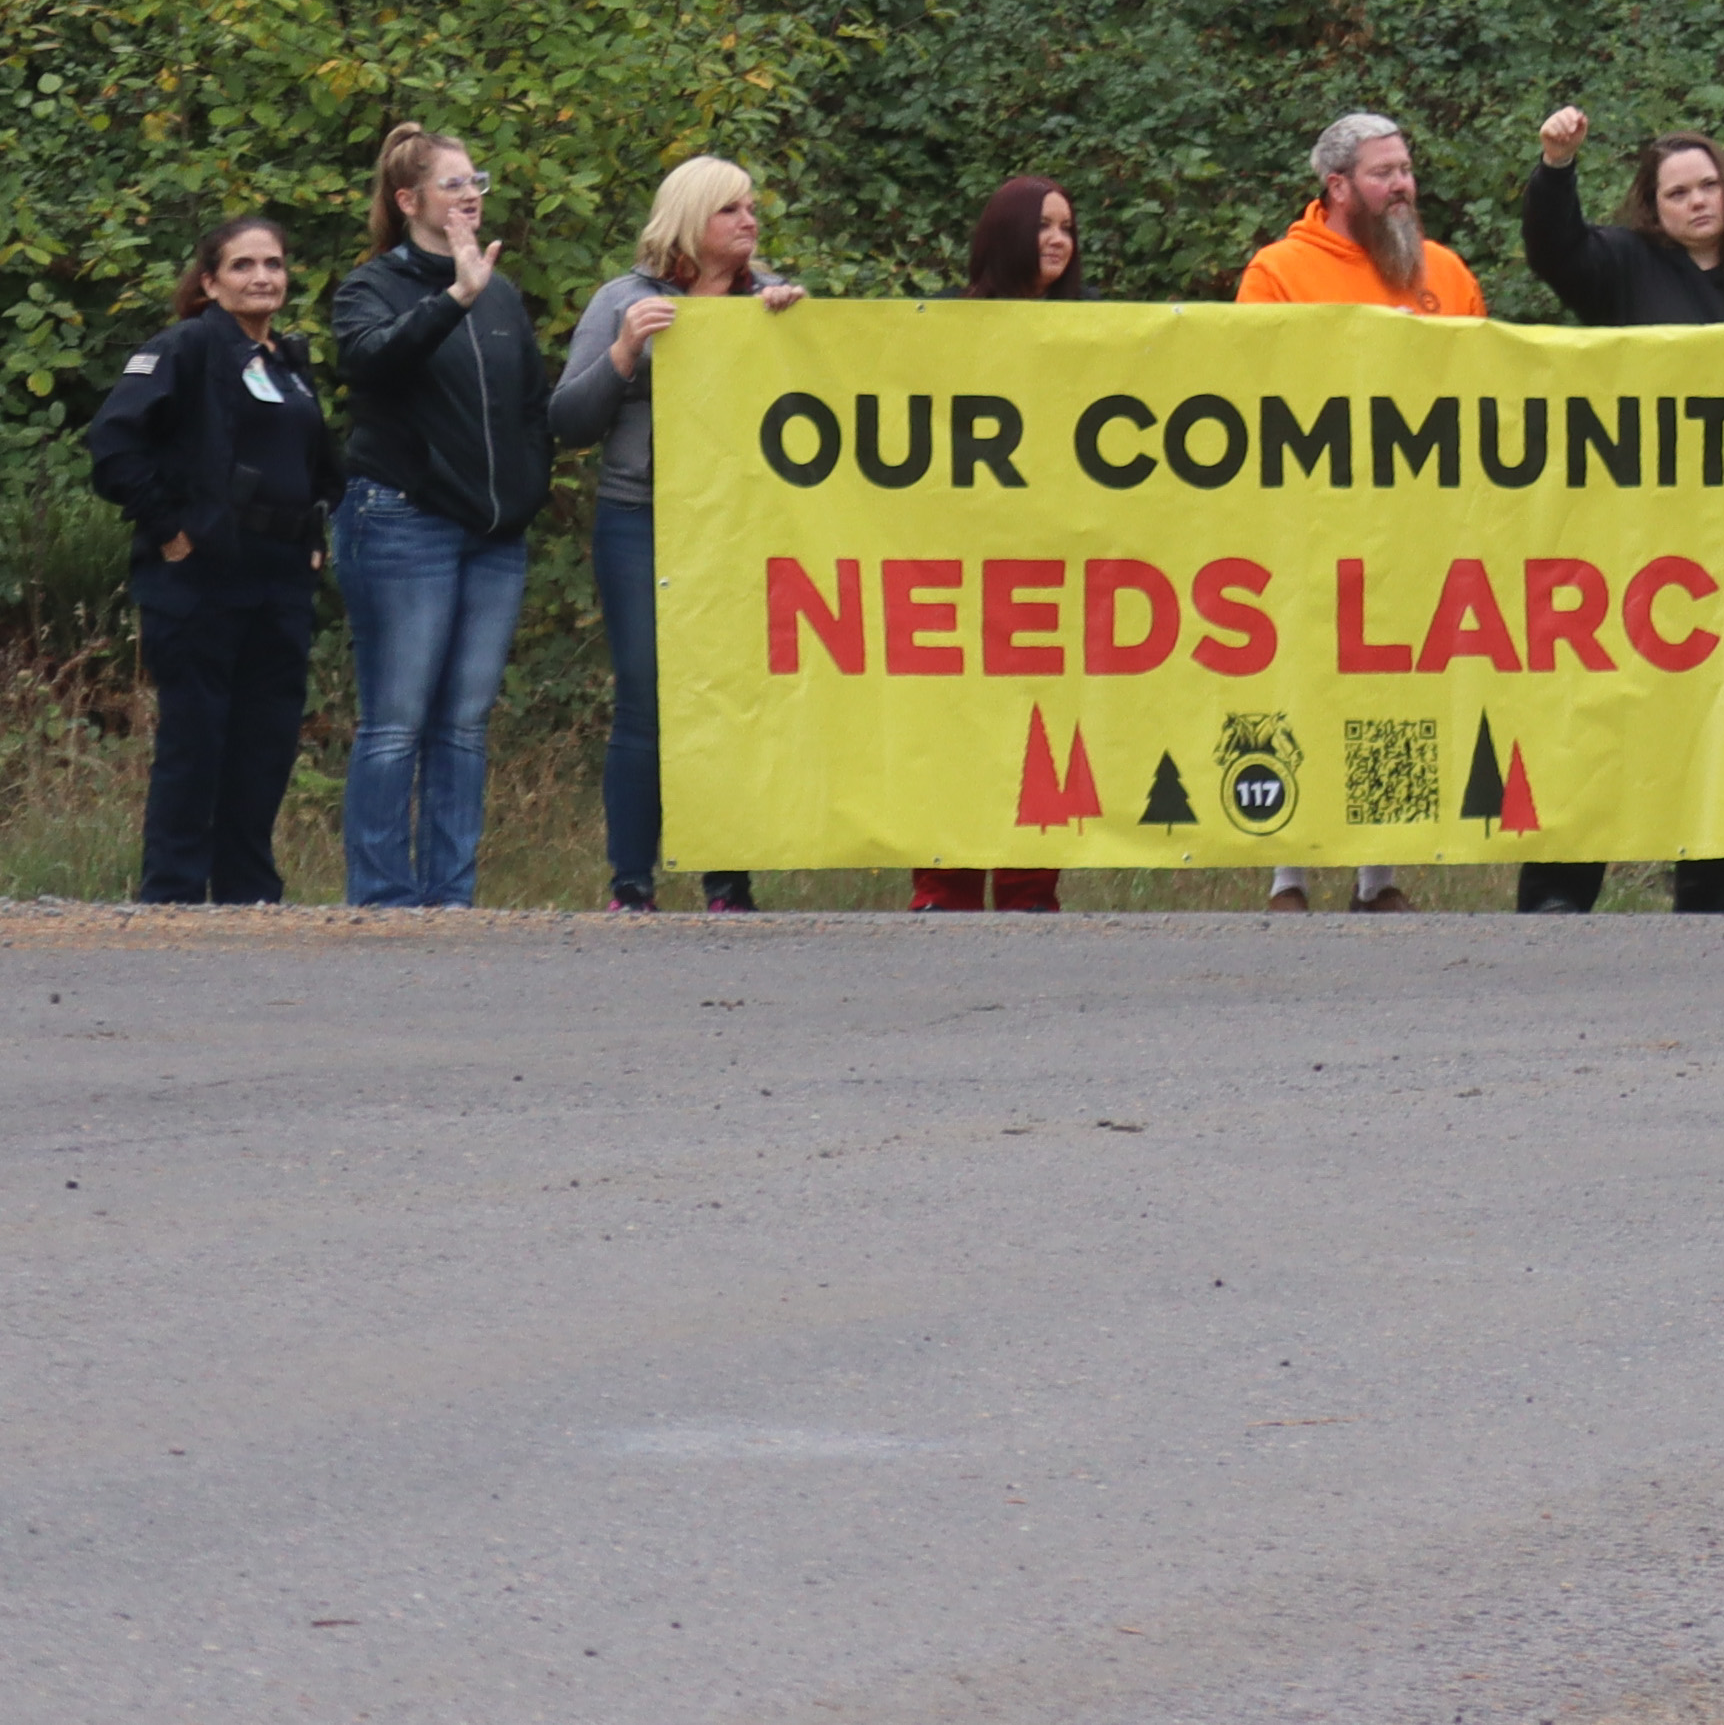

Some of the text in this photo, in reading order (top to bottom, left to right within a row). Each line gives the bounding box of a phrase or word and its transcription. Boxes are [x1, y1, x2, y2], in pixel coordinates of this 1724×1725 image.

[759, 391, 1029, 489] OUR
[765, 556, 1279, 677] NEEDS
[1236, 779, 1281, 808] 117
